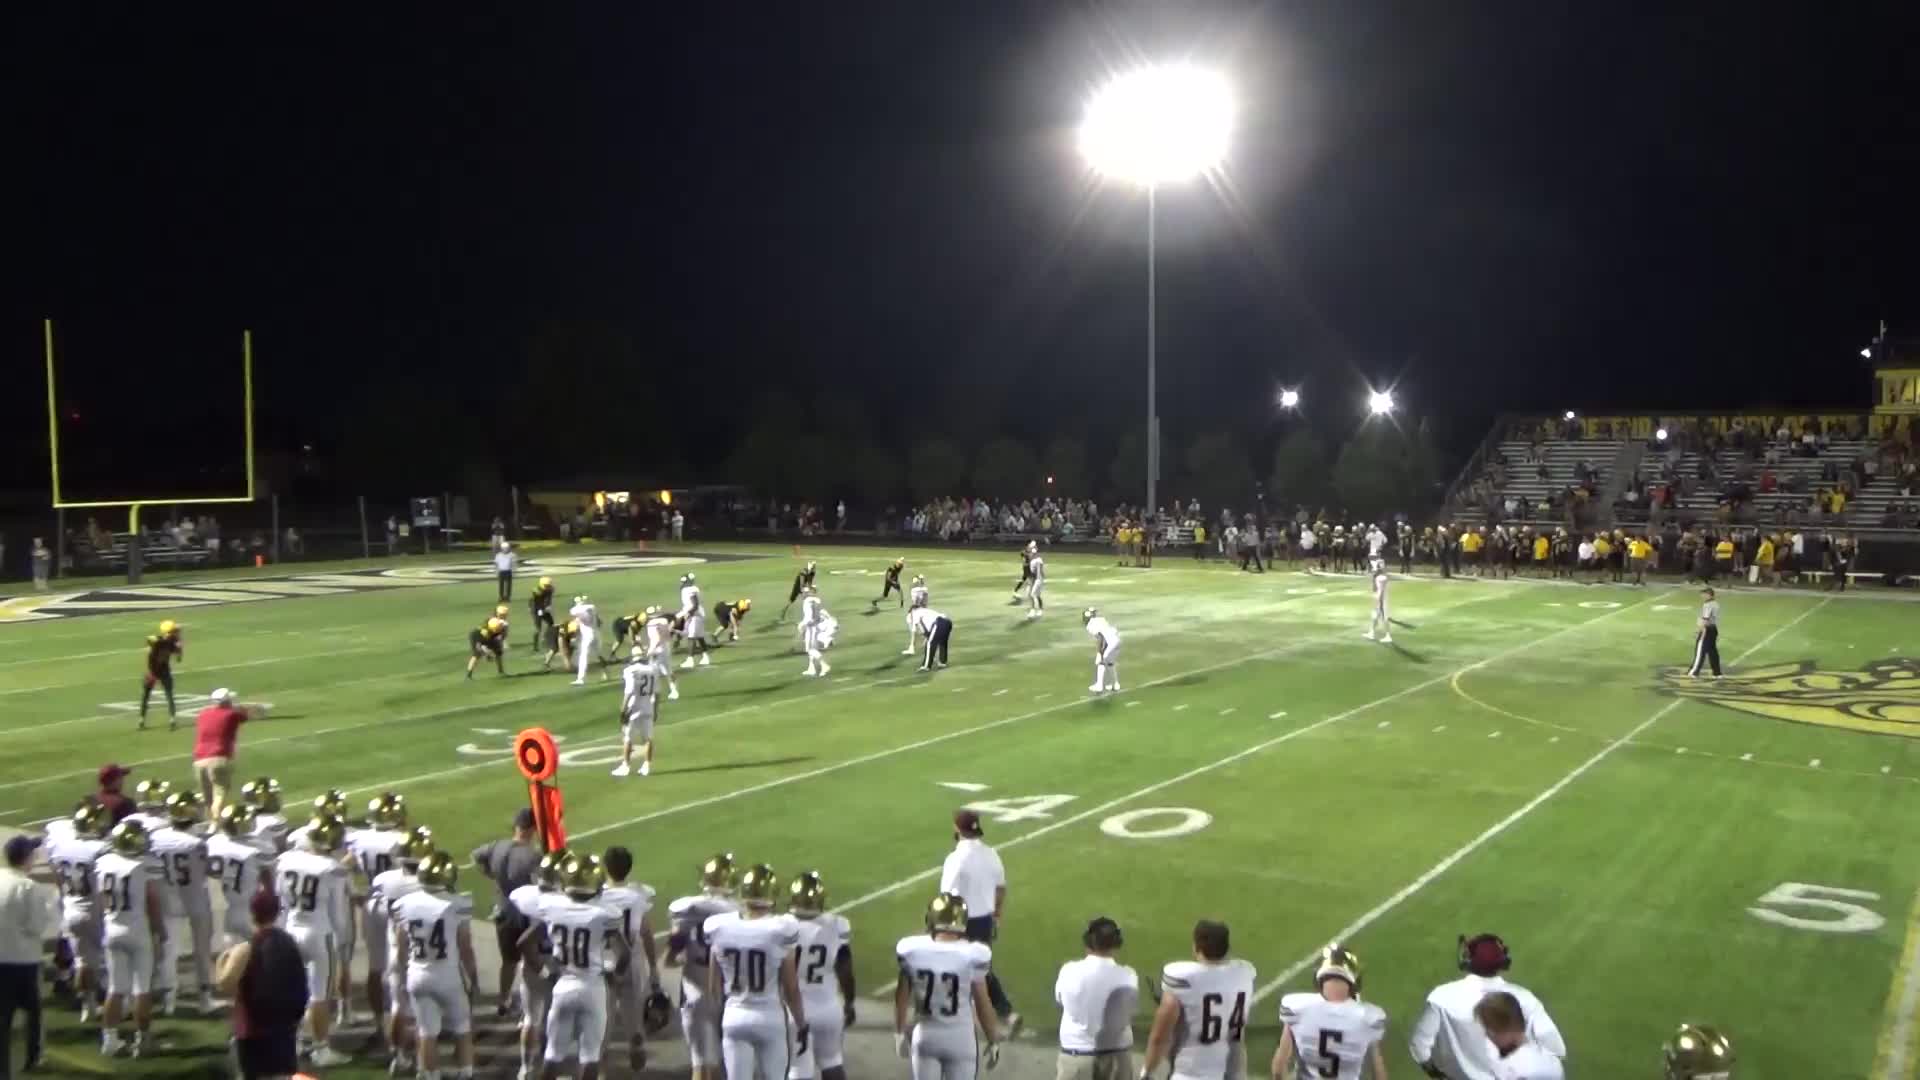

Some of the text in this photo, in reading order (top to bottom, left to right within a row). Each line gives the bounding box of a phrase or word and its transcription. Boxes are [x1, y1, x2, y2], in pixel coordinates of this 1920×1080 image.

[284, 871, 320, 911] 39
[551, 924, 591, 968] 30
[1200, 991, 1247, 1045] 64
[1318, 1028, 1343, 1078] 5
